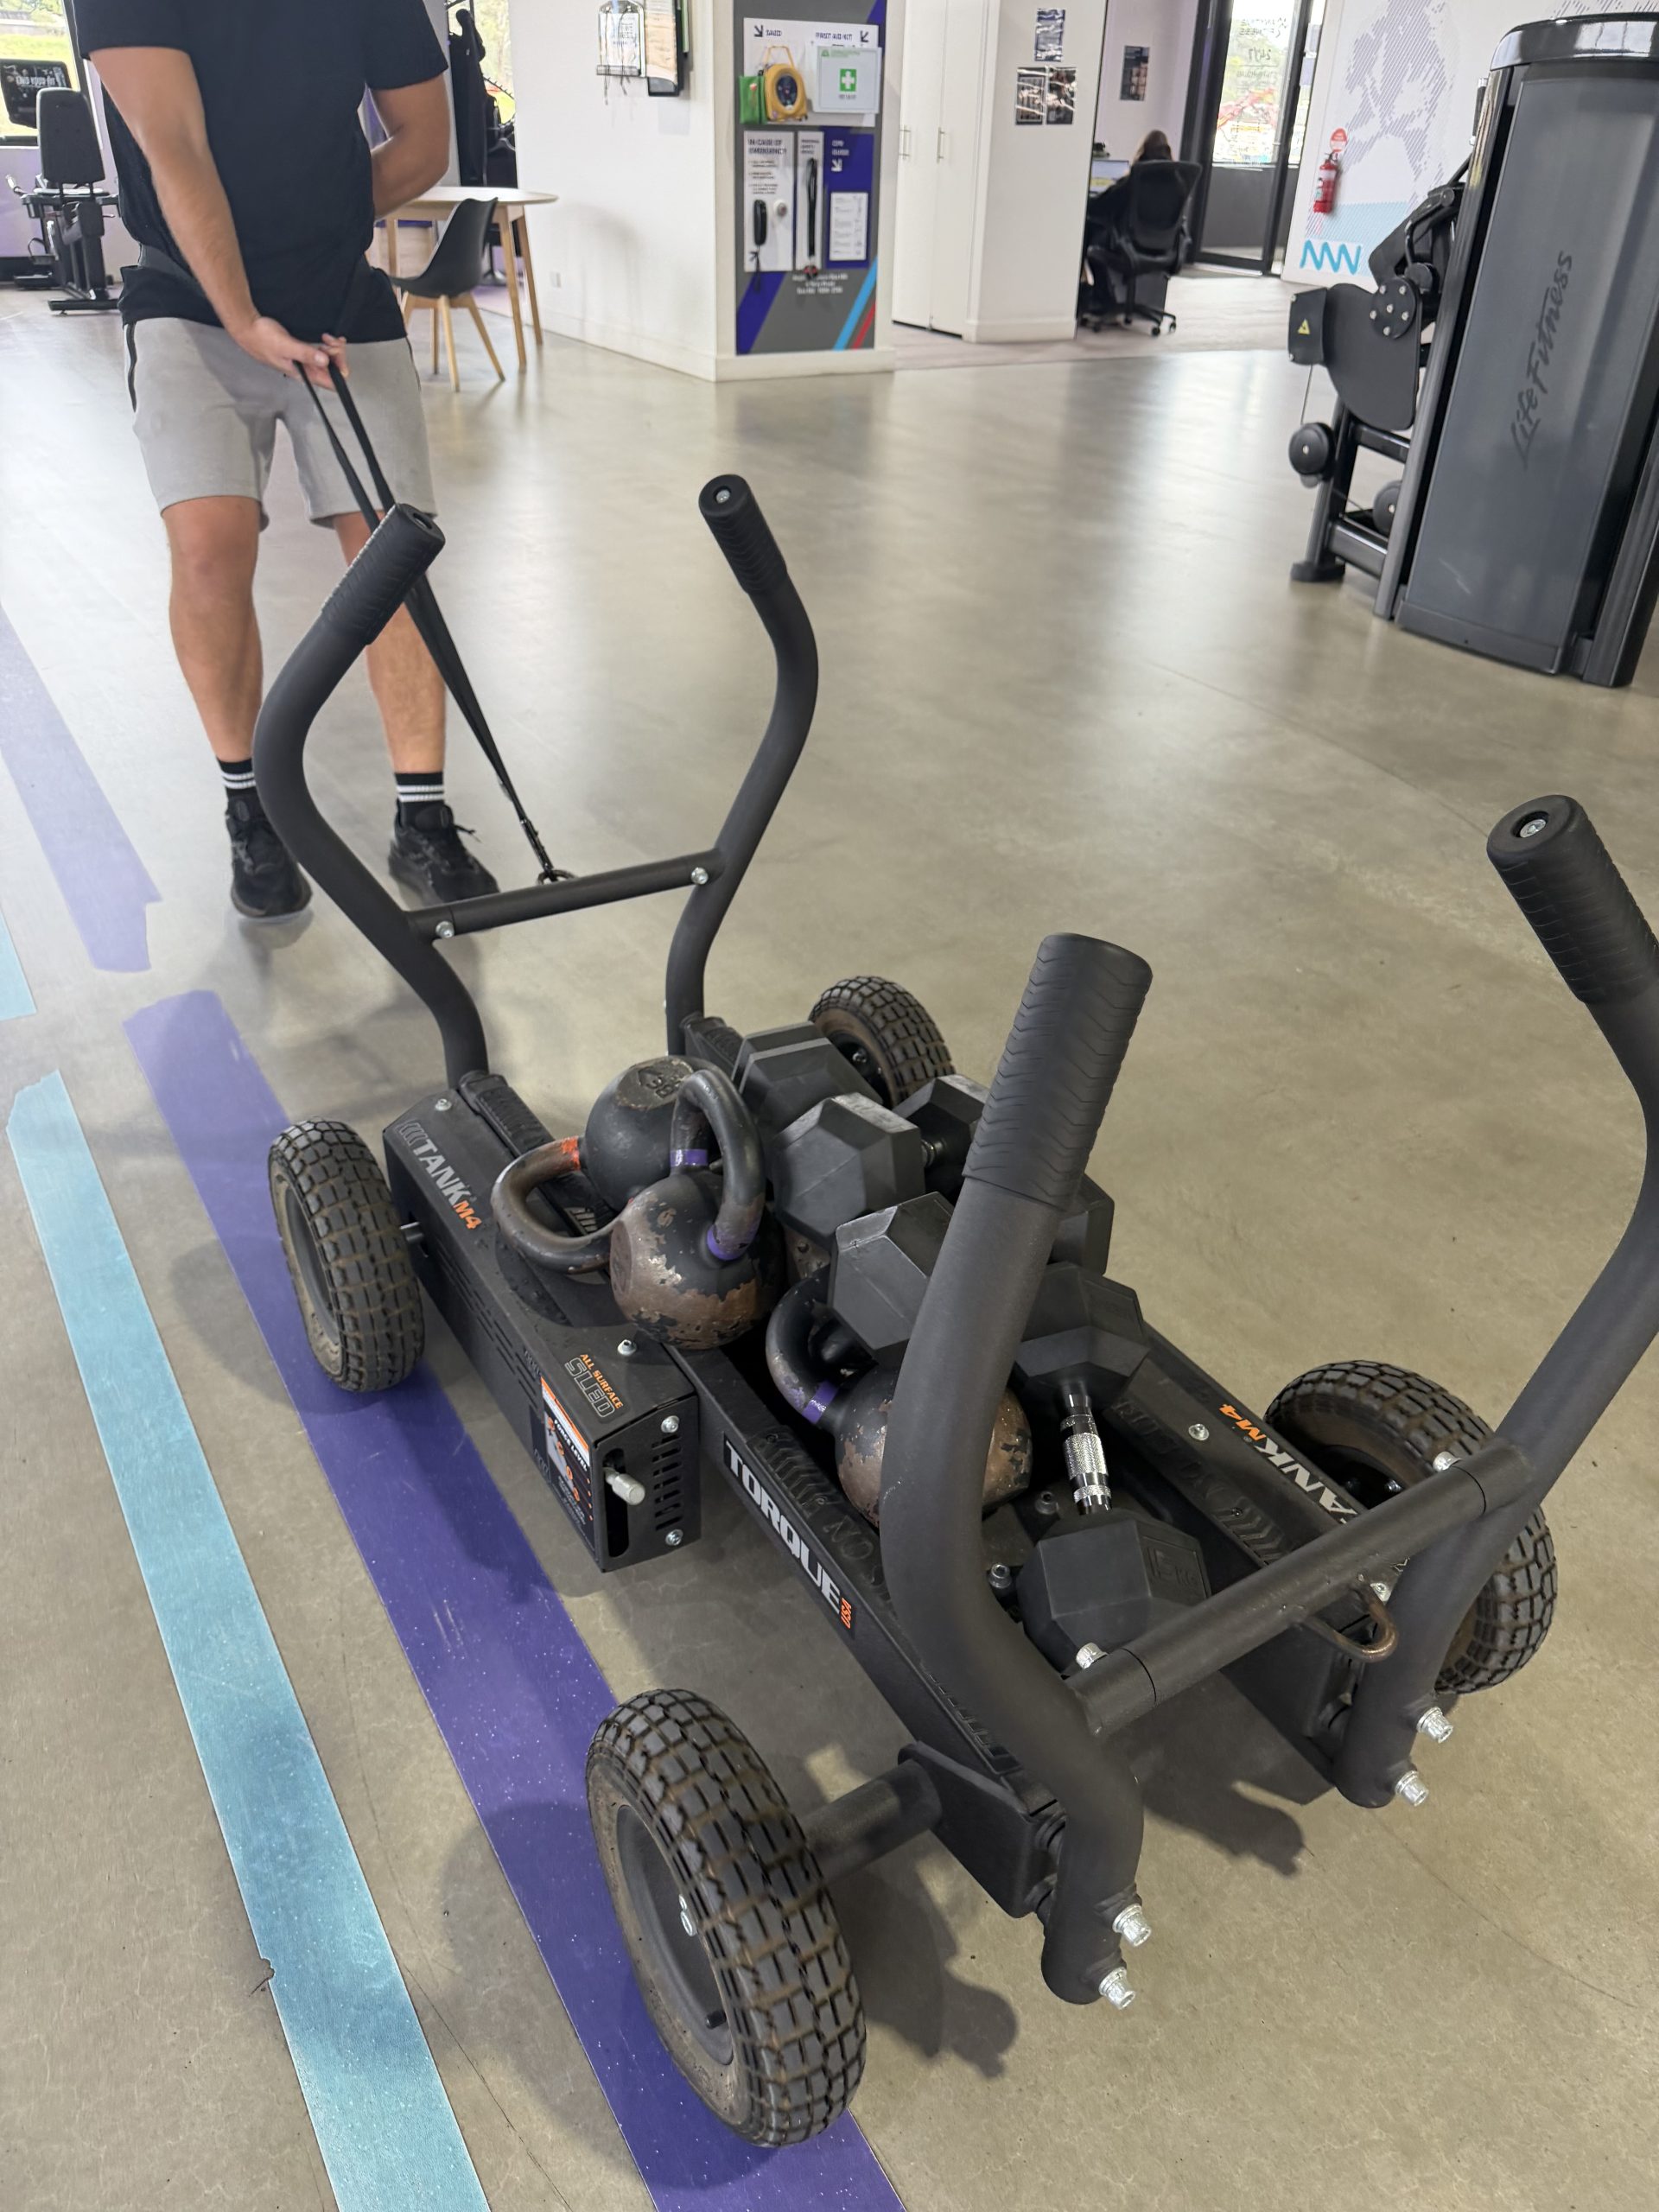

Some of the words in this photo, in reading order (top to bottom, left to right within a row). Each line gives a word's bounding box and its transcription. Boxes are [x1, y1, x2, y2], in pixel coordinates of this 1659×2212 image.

[413, 1138, 471, 1205] TANK
[453, 1199, 482, 1230] M4
[564, 1357, 615, 1418] SLED
[580, 1353, 594, 1370] ALL
[593, 1370, 624, 1409] SURFACE
[554, 1419, 571, 1446] FORCE
[570, 1445, 588, 1472] LEVEL
[1218, 1403, 1267, 1441] M4
[1253, 1436, 1359, 1525] ANK
[726, 1440, 841, 1615] TORQUE
[840, 1597, 852, 1630] USA
